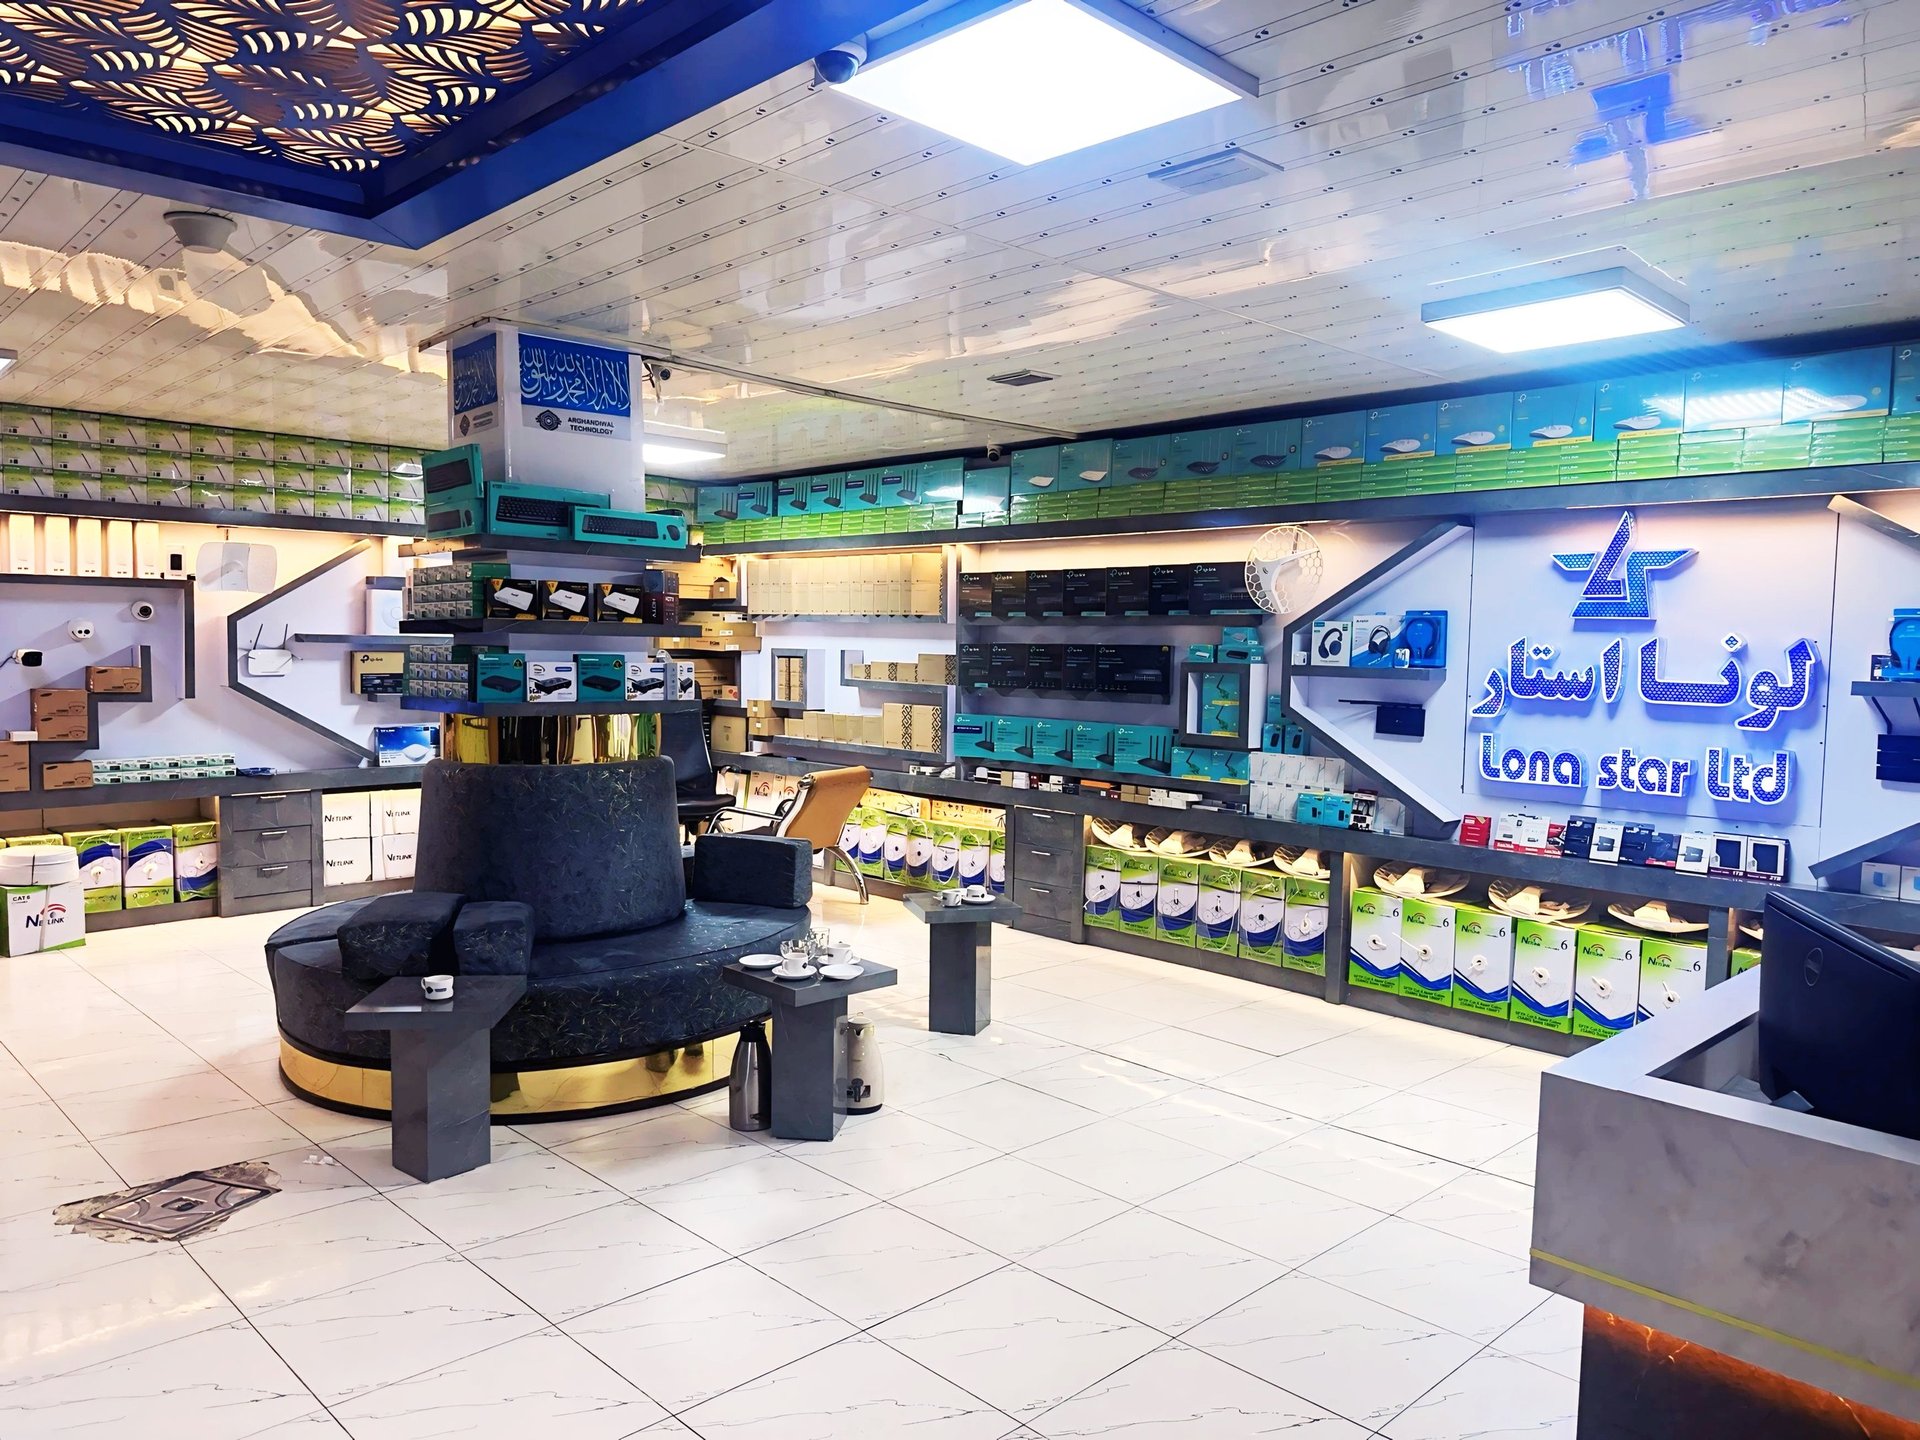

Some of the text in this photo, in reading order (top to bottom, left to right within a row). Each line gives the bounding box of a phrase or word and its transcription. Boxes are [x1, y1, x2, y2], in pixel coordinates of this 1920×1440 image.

[569, 424, 614, 435] TECHNOLOGY
[1470, 631, 1817, 731] لونا استار
[1479, 732, 1587, 788] Lona
[1595, 747, 1693, 797] star
[324, 814, 352, 823] NETLINK
[326, 859, 354, 867] NETLINK
[1392, 907, 1400, 918] 6
[25, 914, 65, 929] NELINK
[1442, 917, 1450, 928] 6
[1498, 927, 1506, 938] 6
[1560, 939, 1568, 951] 6
[1624, 949, 1633, 961] 6
[1692, 960, 1701, 972] 6
